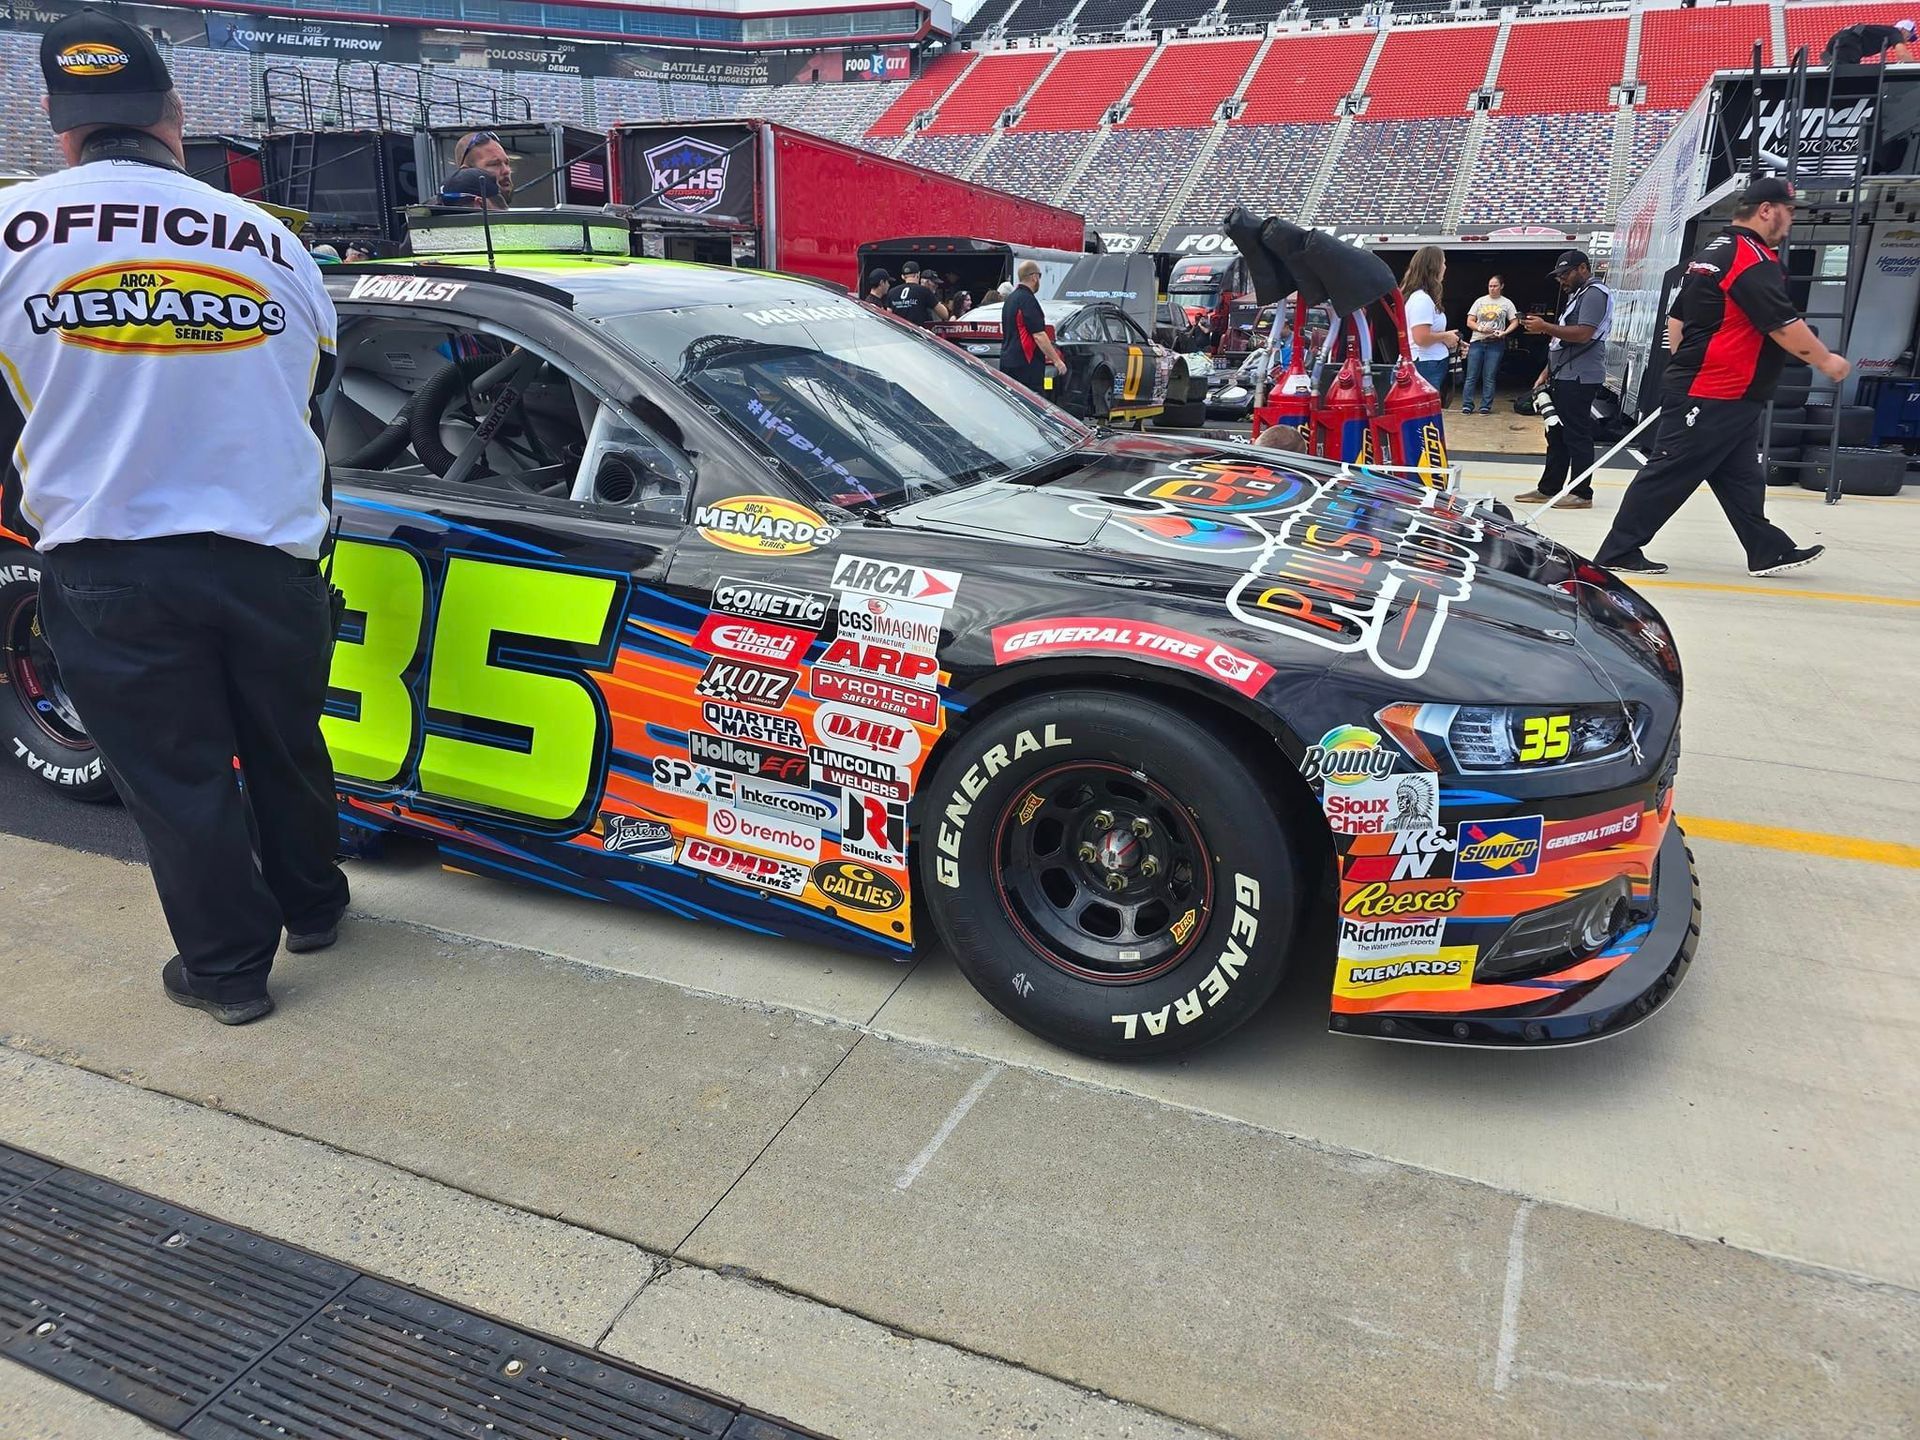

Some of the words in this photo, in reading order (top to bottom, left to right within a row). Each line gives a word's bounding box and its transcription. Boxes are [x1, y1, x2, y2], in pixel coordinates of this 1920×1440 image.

[237, 30, 274, 43] TONY
[277, 34, 331, 47] HELMET
[334, 37, 383, 51] THROW
[558, 44, 576, 52] 2016
[57, 54, 129, 66] MENARDS
[484, 49, 548, 63] COLOSSUS
[550, 53, 567, 64] TV
[548, 64, 580, 73] DEBUTS
[661, 61, 706, 74] BATTLE
[707, 65, 723, 74] AT
[724, 65, 769, 76] BRISTOL
[845, 58, 870, 72] FOOD
[885, 56, 907, 70] CITY
[634, 70, 669, 80] COLLEGE
[670, 72, 717, 82] FOOTBALL'S
[718, 75, 749, 84] BIGGEST
[750, 76, 768, 84] EVER
[3, 203, 294, 272] OFFICIAL
[120, 273, 157, 288] ARCA
[24, 288, 286, 336] MENARDS
[175, 328, 223, 342] SERIES
[976, 325, 999, 333] TIRE
[744, 502, 764, 514] ARCA
[694, 506, 834, 546] MENARDS
[758, 539, 787, 550] SERIES
[833, 559, 916, 597] ARCA
[716, 586, 825, 621] COMETIC
[722, 605, 765, 617] GASKET
[711, 625, 796, 652] Eibach
[838, 630, 856, 639] PRINT
[861, 634, 907, 649] MANUFACTURE
[1003, 626, 1133, 653] GENERAL
[1138, 632, 1204, 660] TIRE
[821, 638, 938, 681] ARP
[709, 663, 790, 700] KLOTZ
[819, 675, 931, 711] PYROTECT
[841, 692, 878, 708] SAFETY
[880, 699, 908, 715] GEAR
[704, 702, 798, 735] QUARTER
[721, 719, 803, 748] MASTER
[1520, 715, 1571, 762] 35
[13, 736, 106, 786] ENERAL
[690, 733, 762, 774] Holley
[812, 748, 891, 782] LINCOLN
[1303, 745, 1397, 782] Bounty
[830, 770, 900, 799] WELDERS
[741, 784, 827, 821] Intercomp
[936, 723, 1073, 889] GENERAL
[1326, 795, 1390, 815] Sioux
[604, 815, 672, 852] Jostens
[740, 817, 816, 852] brembo
[1326, 814, 1385, 834] Chief
[1546, 827, 1599, 850] GENERAL
[1598, 820, 1622, 840] TIRE
[687, 839, 780, 876] COMP
[842, 842, 893, 864] shocks
[1459, 839, 1537, 862] SUNOCO
[746, 871, 792, 891] CAMS
[822, 873, 894, 908] CALLIES
[1341, 882, 1464, 917] Reese's
[1342, 918, 1441, 943] Richmond
[1370, 943, 1389, 951] Water
[1390, 940, 1410, 948] Heater
[1410, 938, 1435, 947] Experts
[1111, 872, 1261, 1040] GENERAL
[1350, 960, 1462, 984] MENARDS
